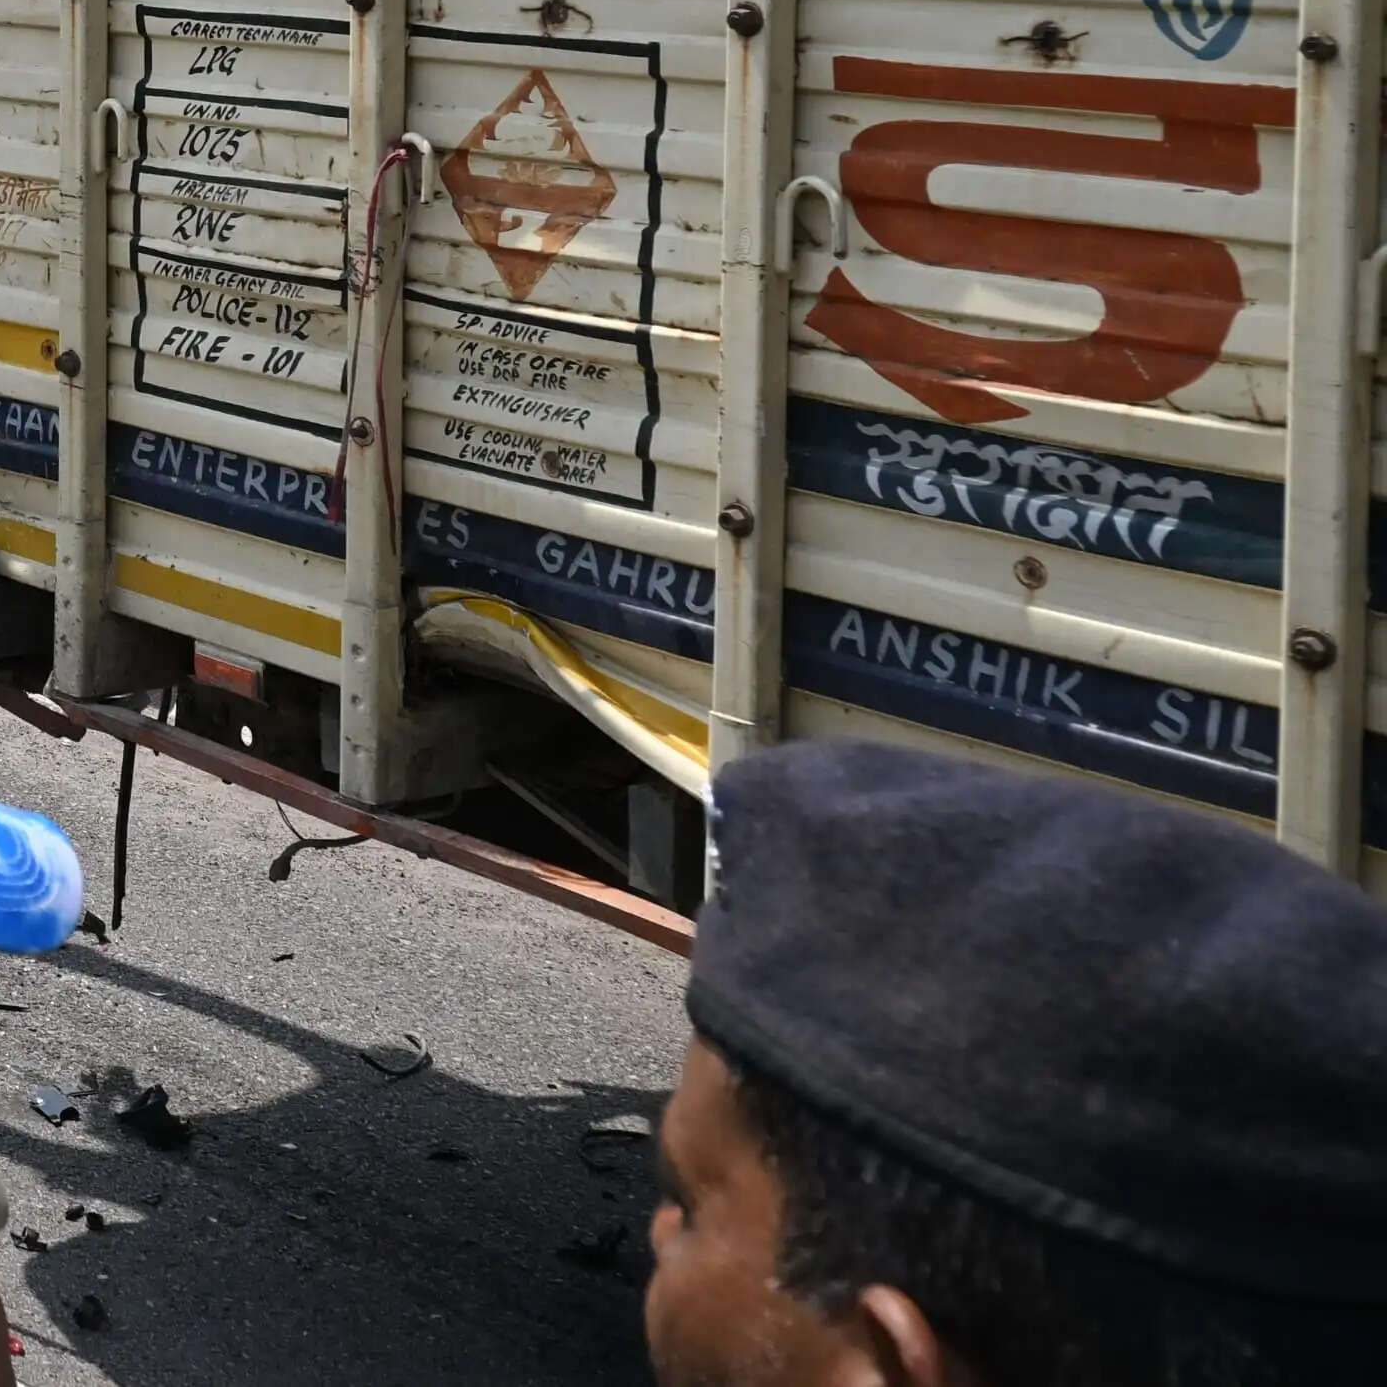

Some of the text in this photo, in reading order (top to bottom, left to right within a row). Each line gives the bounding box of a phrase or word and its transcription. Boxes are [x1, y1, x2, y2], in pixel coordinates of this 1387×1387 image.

[170, 20, 233, 39] CORRECT
[188, 45, 244, 76] LPG
[172, 205, 244, 244] 2WE
[488, 320, 552, 344] ADVICE
[158, 326, 231, 363] FIRE
[262, 345, 306, 379] 101
[455, 340, 479, 354] IN
[480, 347, 528, 368] CASE
[458, 358, 569, 391] USE DCP FIRE
[452, 384, 592, 431] EXTINGUISHER
[444, 420, 608, 474] USE COOLING WATER
[459, 444, 538, 473] EVACUATE
[829, 608, 1084, 715] ANSHIK
